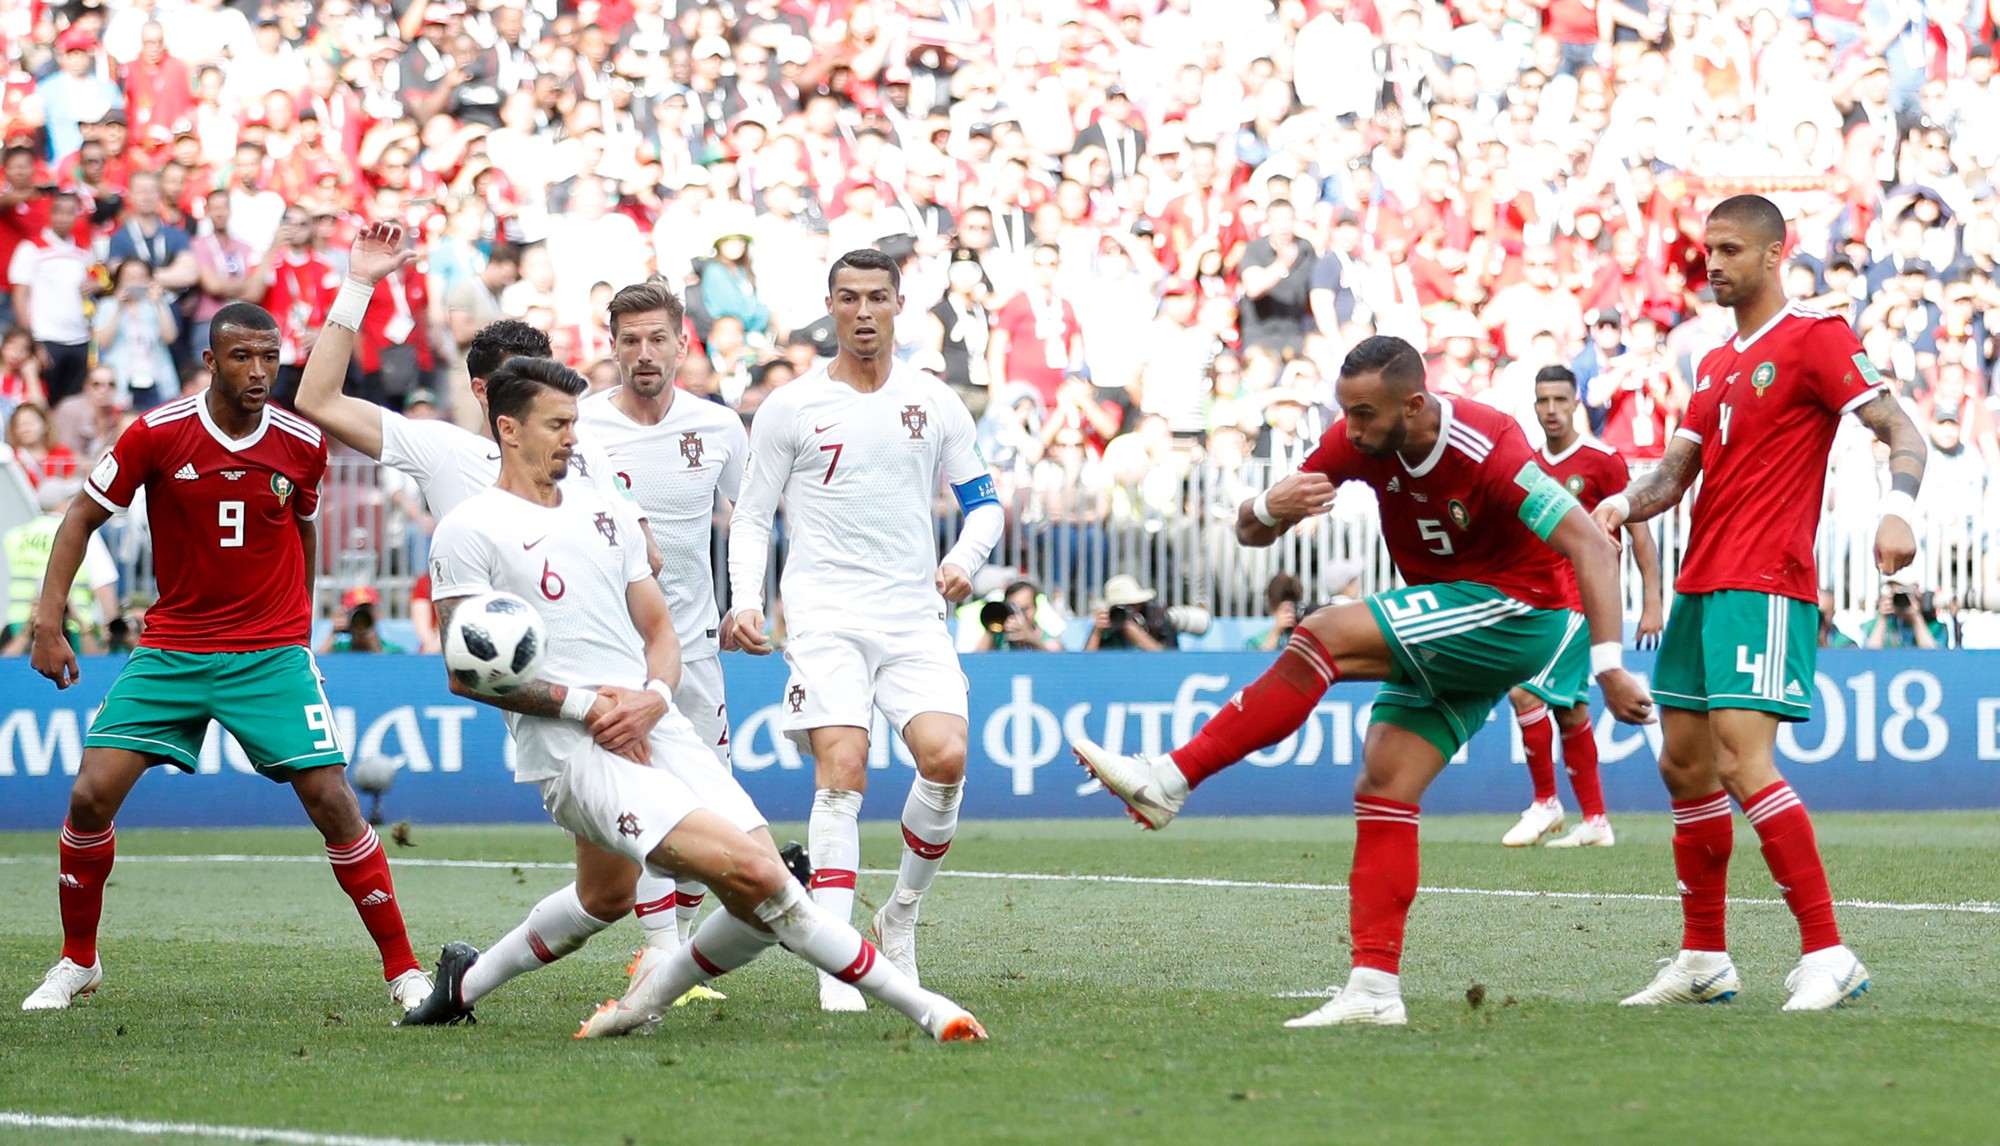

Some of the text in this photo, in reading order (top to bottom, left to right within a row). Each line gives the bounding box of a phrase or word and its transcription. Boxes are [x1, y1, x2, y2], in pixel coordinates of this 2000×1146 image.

[1719, 402, 1732, 446] 4
[819, 443, 844, 485] 7
[219, 501, 244, 547] 9
[1416, 519, 1453, 555] 5
[540, 557, 566, 601] 6
[1383, 590, 1440, 620] 5
[1736, 645, 1764, 693] 4
[304, 703, 335, 750] 9
[1776, 668, 1949, 764] 018
